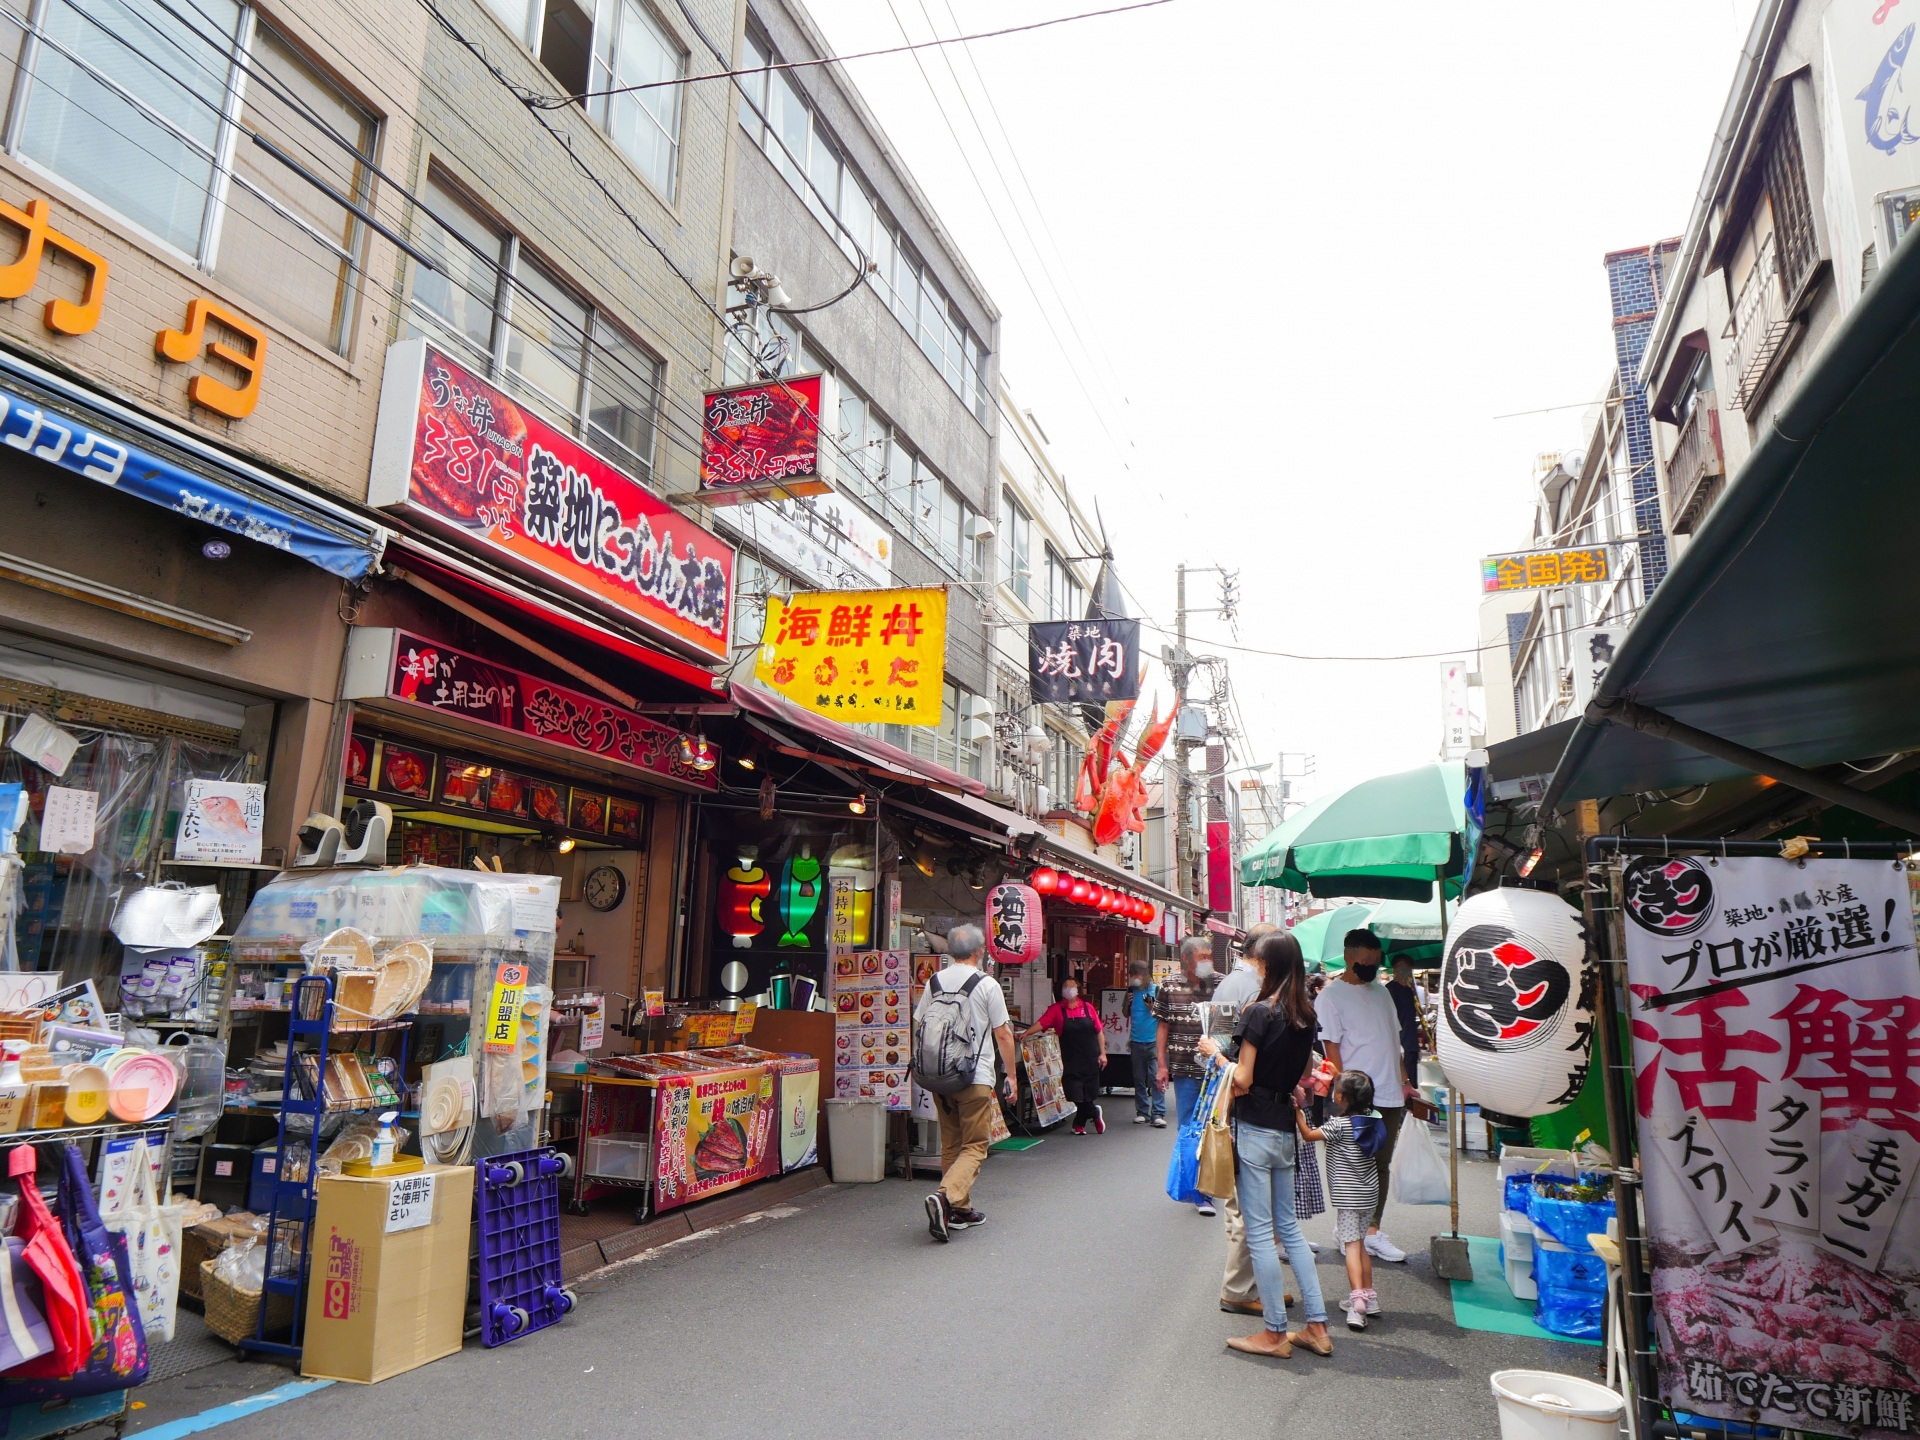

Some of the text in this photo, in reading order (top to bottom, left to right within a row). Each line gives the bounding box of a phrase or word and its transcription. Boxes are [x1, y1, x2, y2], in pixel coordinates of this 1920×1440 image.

[487, 429, 522, 458] UNADON
[774, 603, 925, 649] 海鮮丼
[1067, 624, 1101, 641] 築地
[1037, 637, 1126, 680] 焼肉
[243, 785, 262, 831] 築地に
[1661, 897, 1897, 991] プロが厳選!
[494, 987, 516, 1040] 加盟店
[1668, 1115, 1752, 1243] ズワイ
[1759, 1094, 1810, 1219] タラバ
[391, 1190, 430, 1206] ご使用下
[392, 1176, 431, 1192] 入店前に
[1821, 1137, 1902, 1259] 毛ガニ
[390, 1207, 410, 1222] さい
[1688, 1361, 1916, 1432] 茹でたて新鮮
